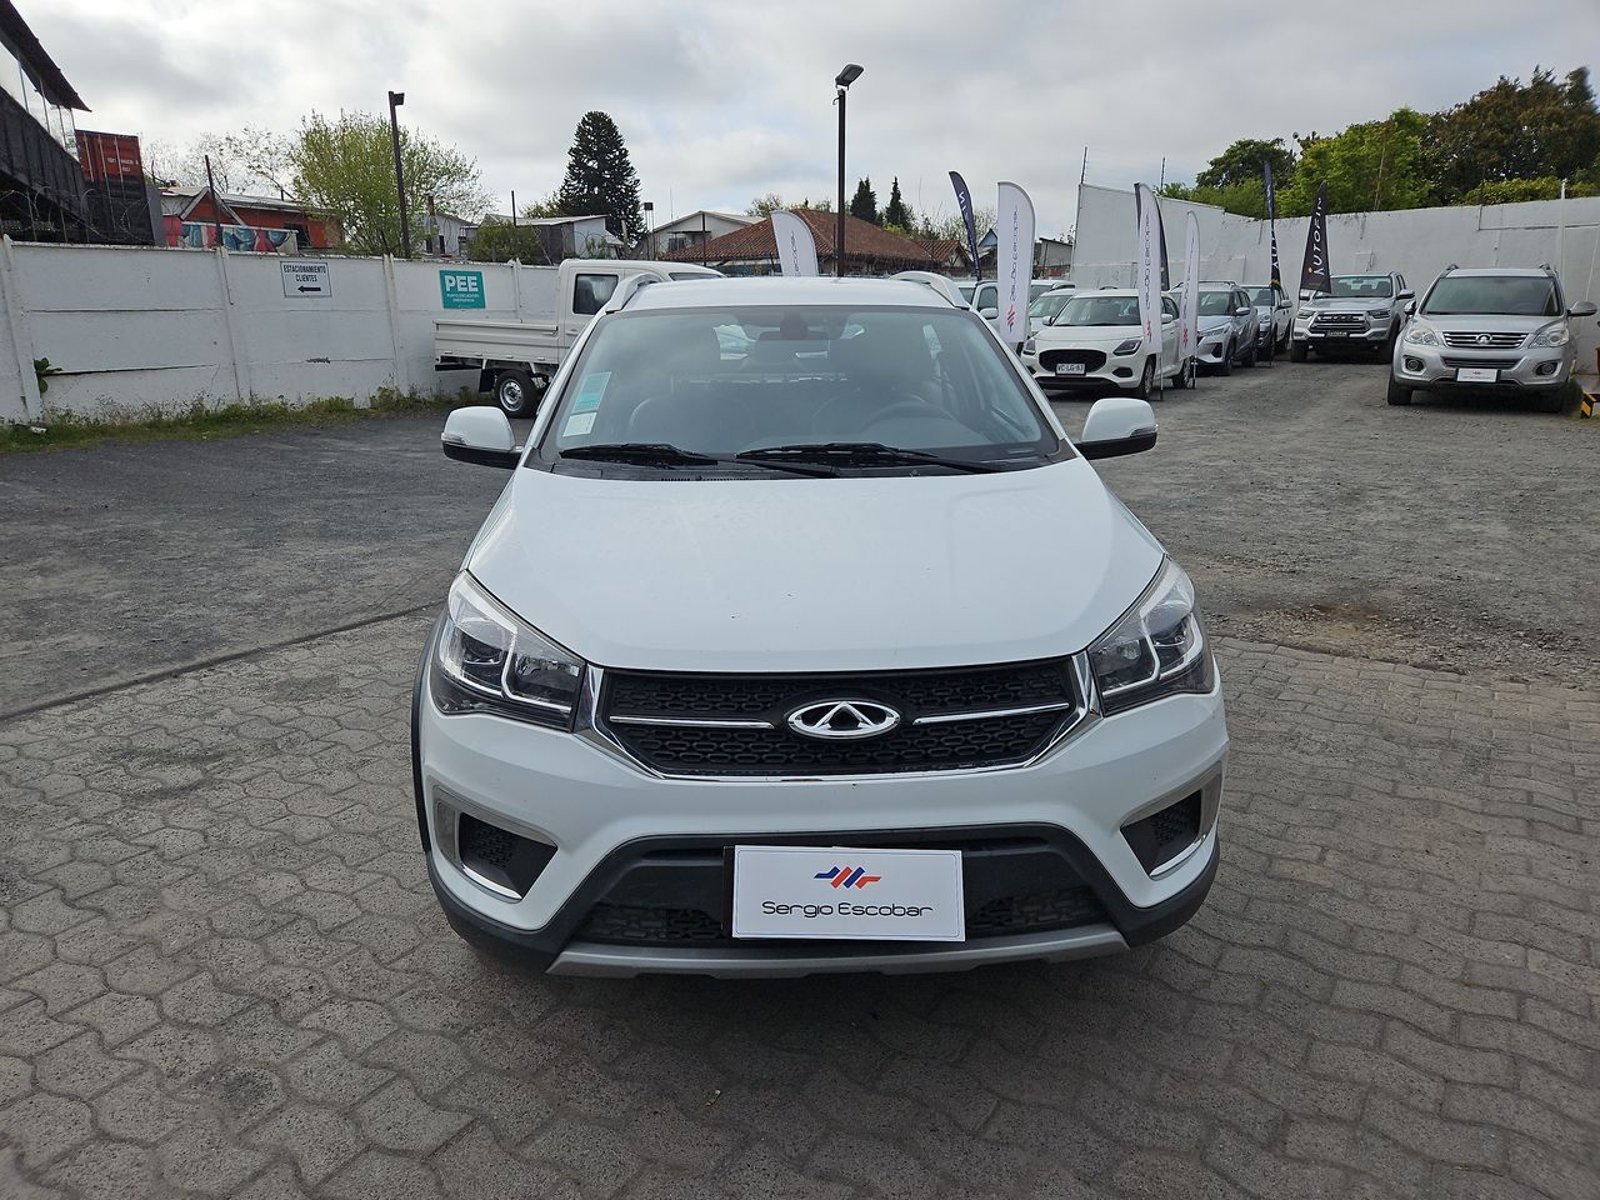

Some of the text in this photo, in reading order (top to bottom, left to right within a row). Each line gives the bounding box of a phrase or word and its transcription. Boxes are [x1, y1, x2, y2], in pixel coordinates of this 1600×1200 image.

[1312, 197, 1326, 276] AUTOFIN
[295, 274, 317, 282] CLIENTES
[444, 275, 479, 292] PEE
[761, 901, 933, 918] Sergio Escobar
